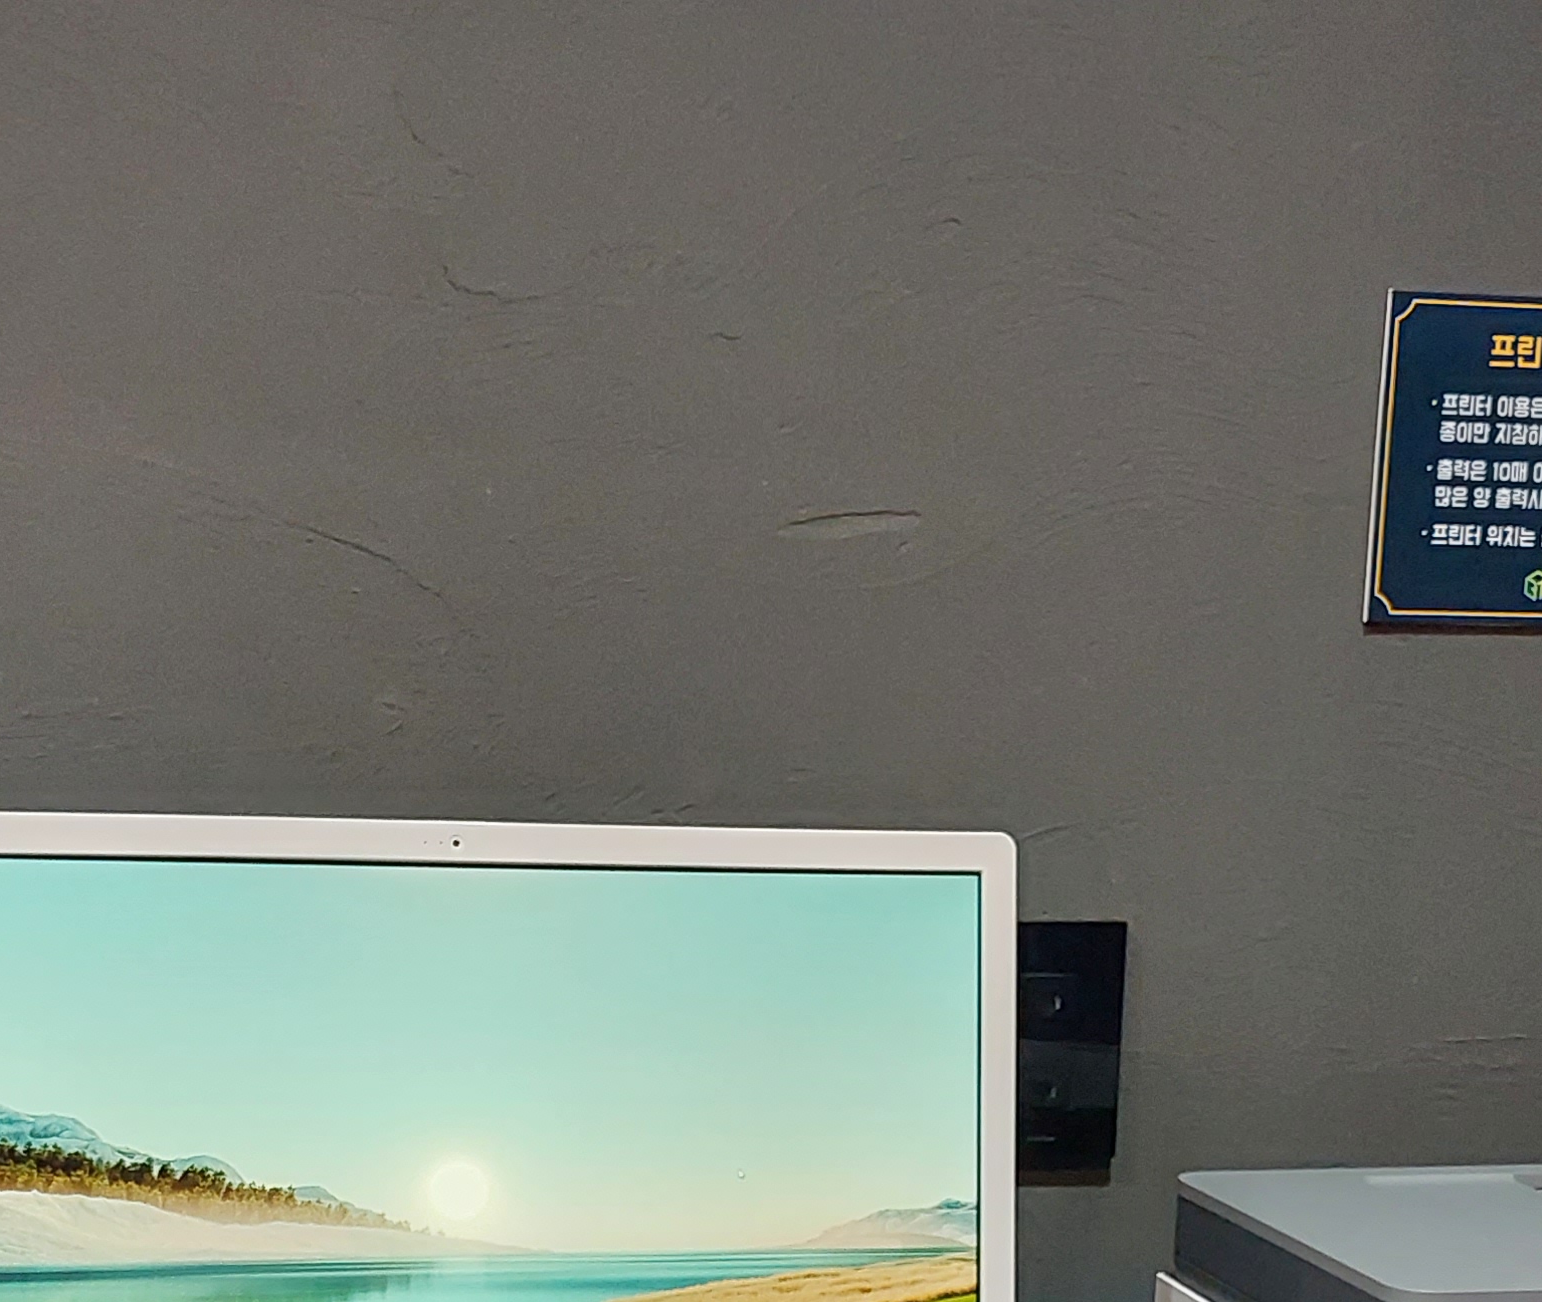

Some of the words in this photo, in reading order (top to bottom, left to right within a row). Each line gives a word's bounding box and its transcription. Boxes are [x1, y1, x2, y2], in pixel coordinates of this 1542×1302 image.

[1440, 394, 1493, 417] 프린터
[1439, 421, 1492, 444] 종이만
[1436, 459, 1488, 482] 출력은
[1493, 461, 1529, 483] 10매
[1434, 486, 1469, 508] 많은
[1473, 487, 1492, 509] 양
[1430, 524, 1482, 546] 프린터
[1485, 525, 1537, 548] 위치는
